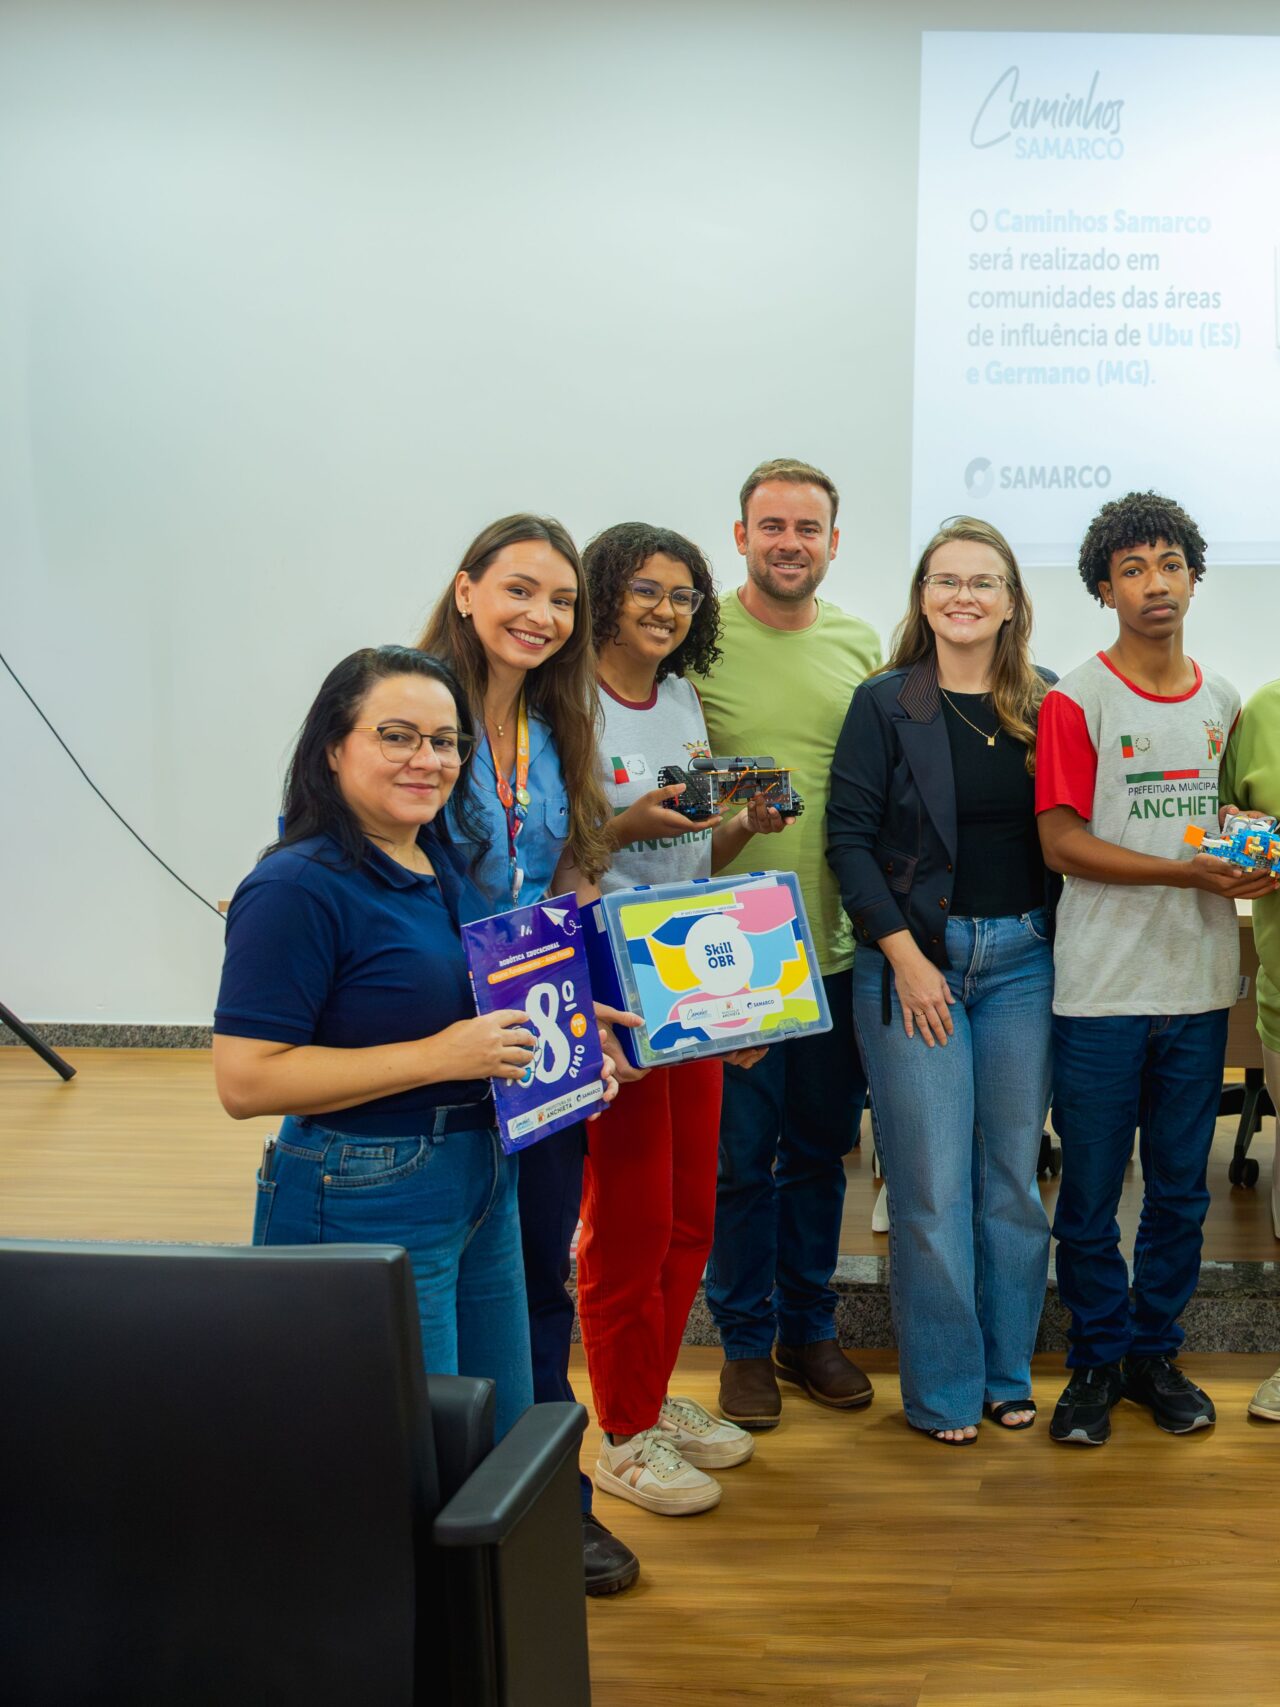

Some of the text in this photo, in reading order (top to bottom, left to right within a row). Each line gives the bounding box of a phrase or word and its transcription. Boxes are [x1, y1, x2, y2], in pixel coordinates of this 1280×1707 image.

[970, 65, 1125, 149] Caminhos
[1015, 136, 1125, 160] SAMARCO
[969, 208, 1211, 233] O Caminhos Samarco
[968, 247, 1160, 271] será realizado em
[967, 285, 1222, 309] comunidades das áreas
[967, 322, 1241, 350] de influência de Ubu (ES)
[965, 359, 1156, 387] e Germano (MG).
[1000, 465, 1112, 489] SAMARCO
[1128, 784, 1177, 796] PREFEITURA
[1128, 796, 1218, 820] ANCHIET
[704, 942, 733, 956] Skill
[708, 954, 736, 969] OBR
[569, 1044, 586, 1079] ano
